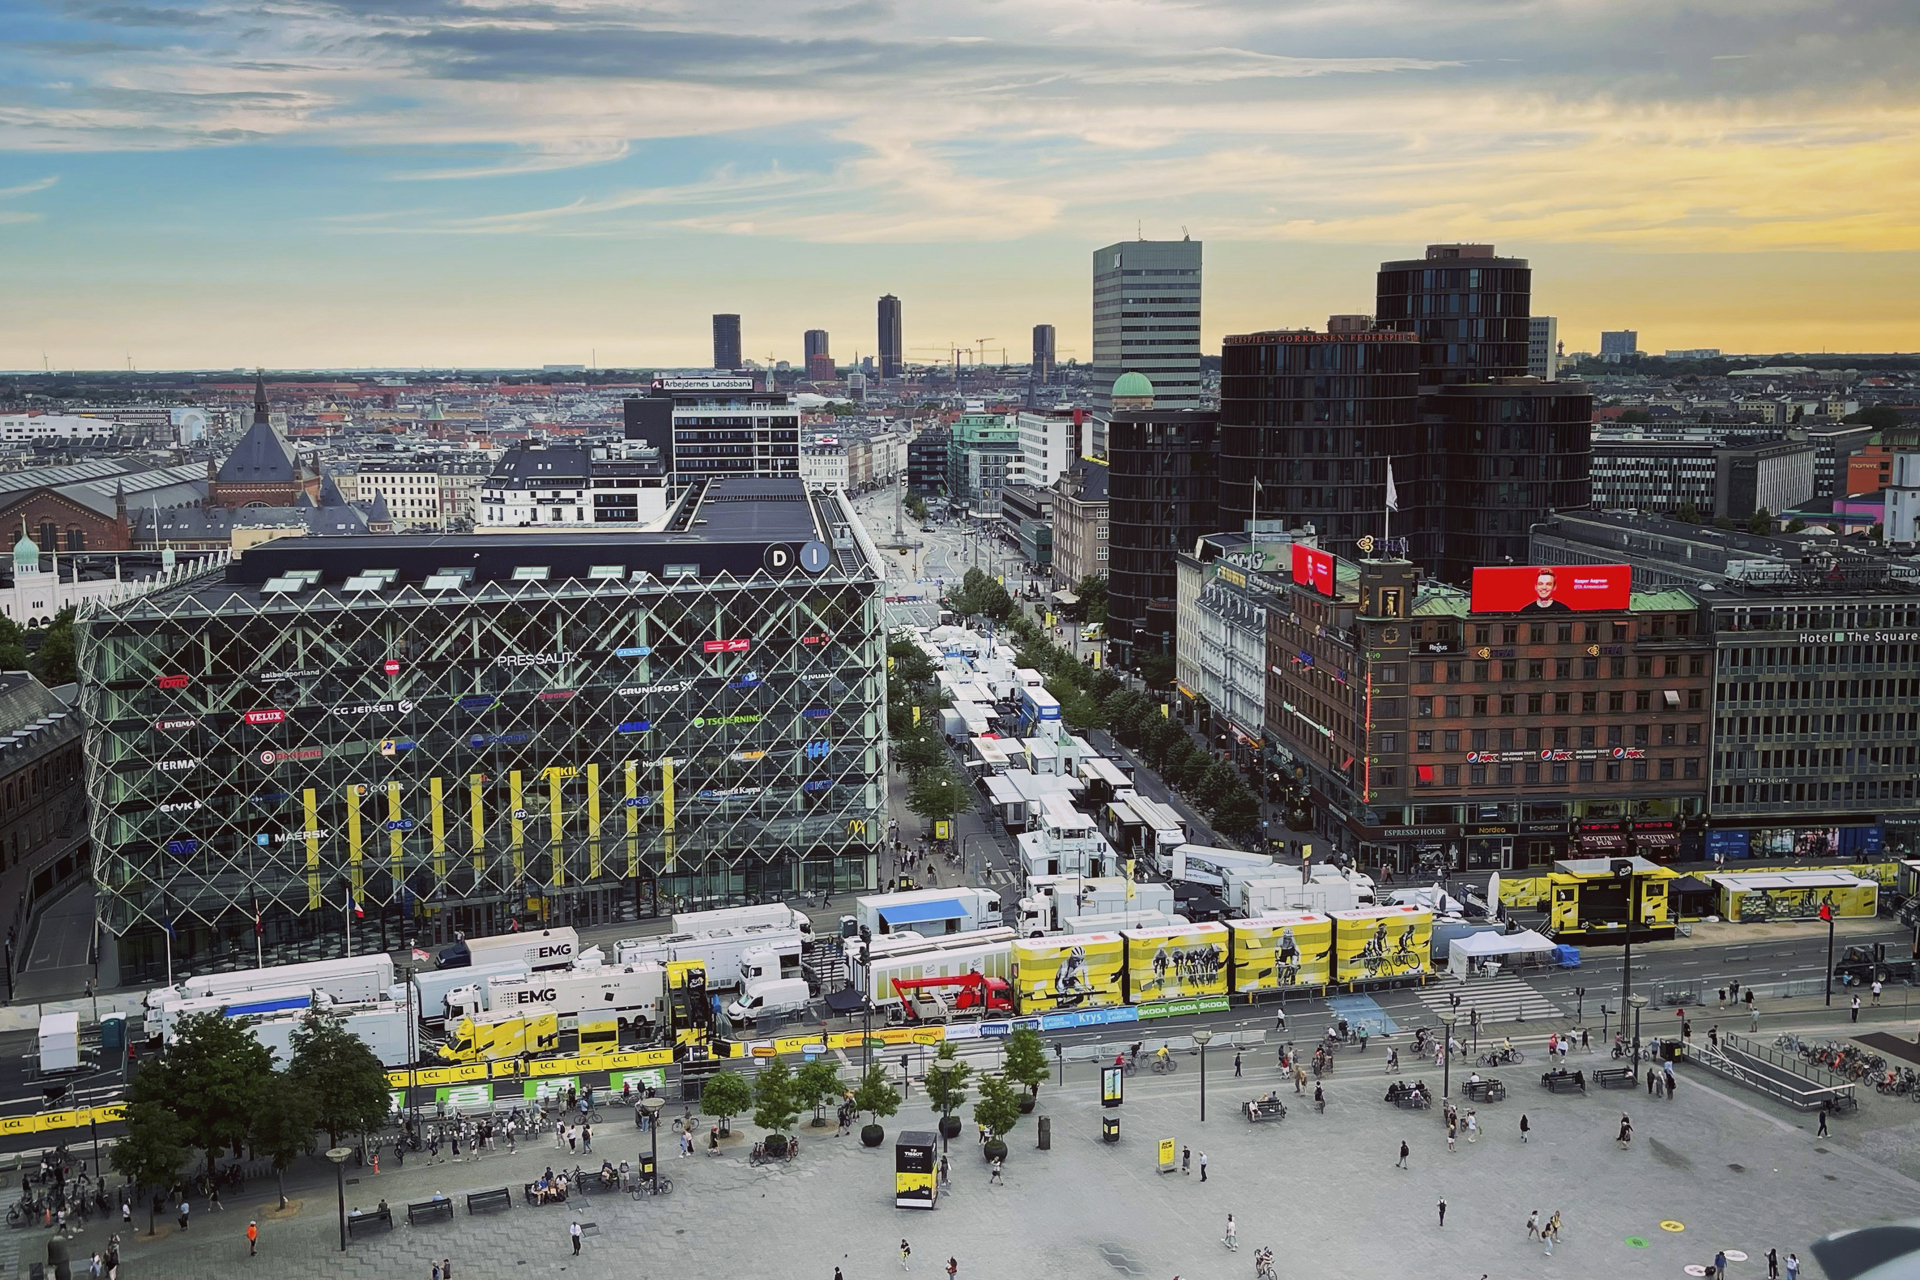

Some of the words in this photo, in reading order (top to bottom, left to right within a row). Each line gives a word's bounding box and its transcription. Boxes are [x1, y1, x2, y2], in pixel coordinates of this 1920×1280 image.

[1278, 334, 1344, 343] GORRISSEN
[1350, 333, 1406, 342] FEDERSPIEL
[664, 380, 710, 389] Arbejdernes
[712, 379, 751, 388] Landsbank
[773, 550, 787, 566] D
[1799, 632, 1833, 643] Hotel
[1847, 632, 1870, 642] The
[1875, 631, 1918, 644] Square
[1429, 643, 1448, 653] Regus
[497, 652, 573, 667] PRESSALIT
[619, 684, 679, 696] GRUNDFOS
[333, 707, 349, 715] CG
[351, 704, 394, 714] JENSEN
[248, 712, 282, 722] VELUX
[707, 714, 761, 726] TSCHERNING
[164, 720, 196, 729] BYGMA
[157, 760, 196, 771] TERMA
[642, 759, 666, 768] Nordic
[667, 758, 686, 767] Sugar
[713, 788, 739, 797] Smurfit
[739, 786, 761, 795] Kappa
[160, 802, 194, 813] eryk
[388, 820, 412, 830] JKS
[1478, 826, 1506, 834] Nordea
[274, 828, 329, 843] MAERSK
[1384, 828, 1420, 836] ESPRESSO
[1420, 828, 1447, 836] HOUSE
[1343, 908, 1397, 917] Orange
[1242, 917, 1296, 927] Orange
[1136, 926, 1193, 936] Orange
[1029, 936, 1086, 947] Orange
[539, 943, 572, 958] EMG
[517, 988, 557, 1004] EMG
[1168, 1004, 1198, 1014] ŠKODA
[1199, 1000, 1228, 1010] ŠKODA
[1138, 1007, 1167, 1017] ŠKODA
[1079, 1013, 1102, 1024] Krys
[612, 1055, 629, 1063] LCL
[648, 1052, 665, 1060] LCL
[103, 1108, 118, 1116] LC
[47, 1115, 67, 1123] LCL
[4, 1120, 24, 1129] LCL
